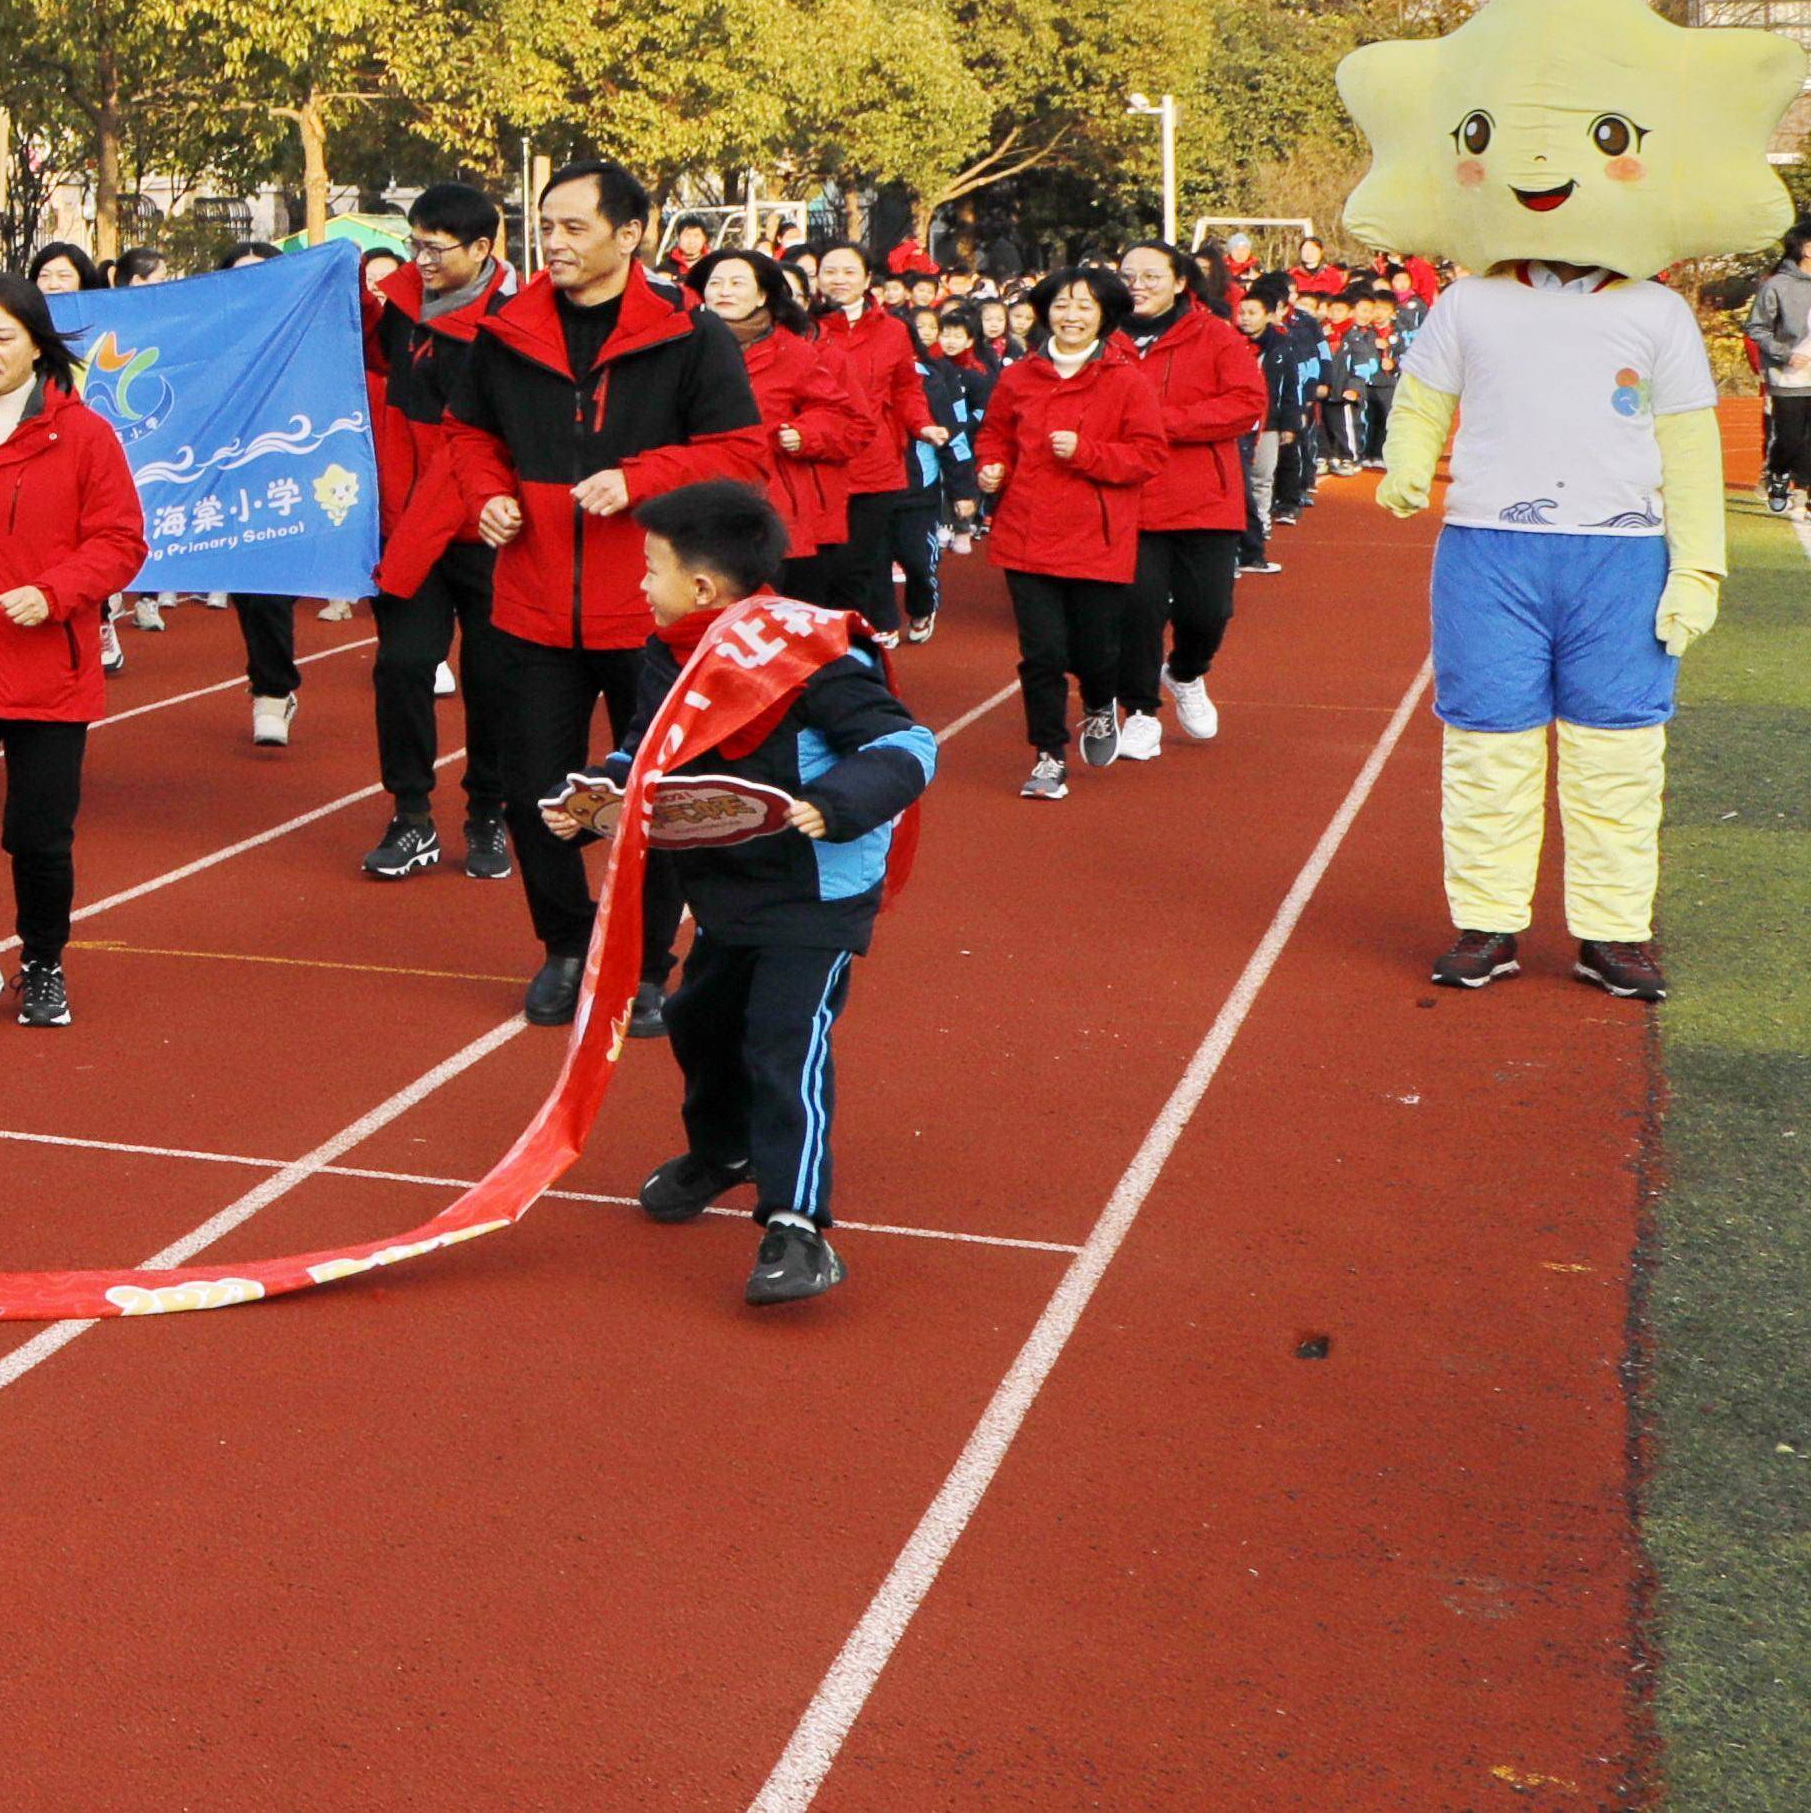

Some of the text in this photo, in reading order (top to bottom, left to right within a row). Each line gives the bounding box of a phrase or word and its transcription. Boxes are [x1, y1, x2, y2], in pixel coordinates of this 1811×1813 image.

[152, 477, 303, 540] 海棠小学
[166, 535, 239, 556] Primary
[243, 520, 305, 544] School
